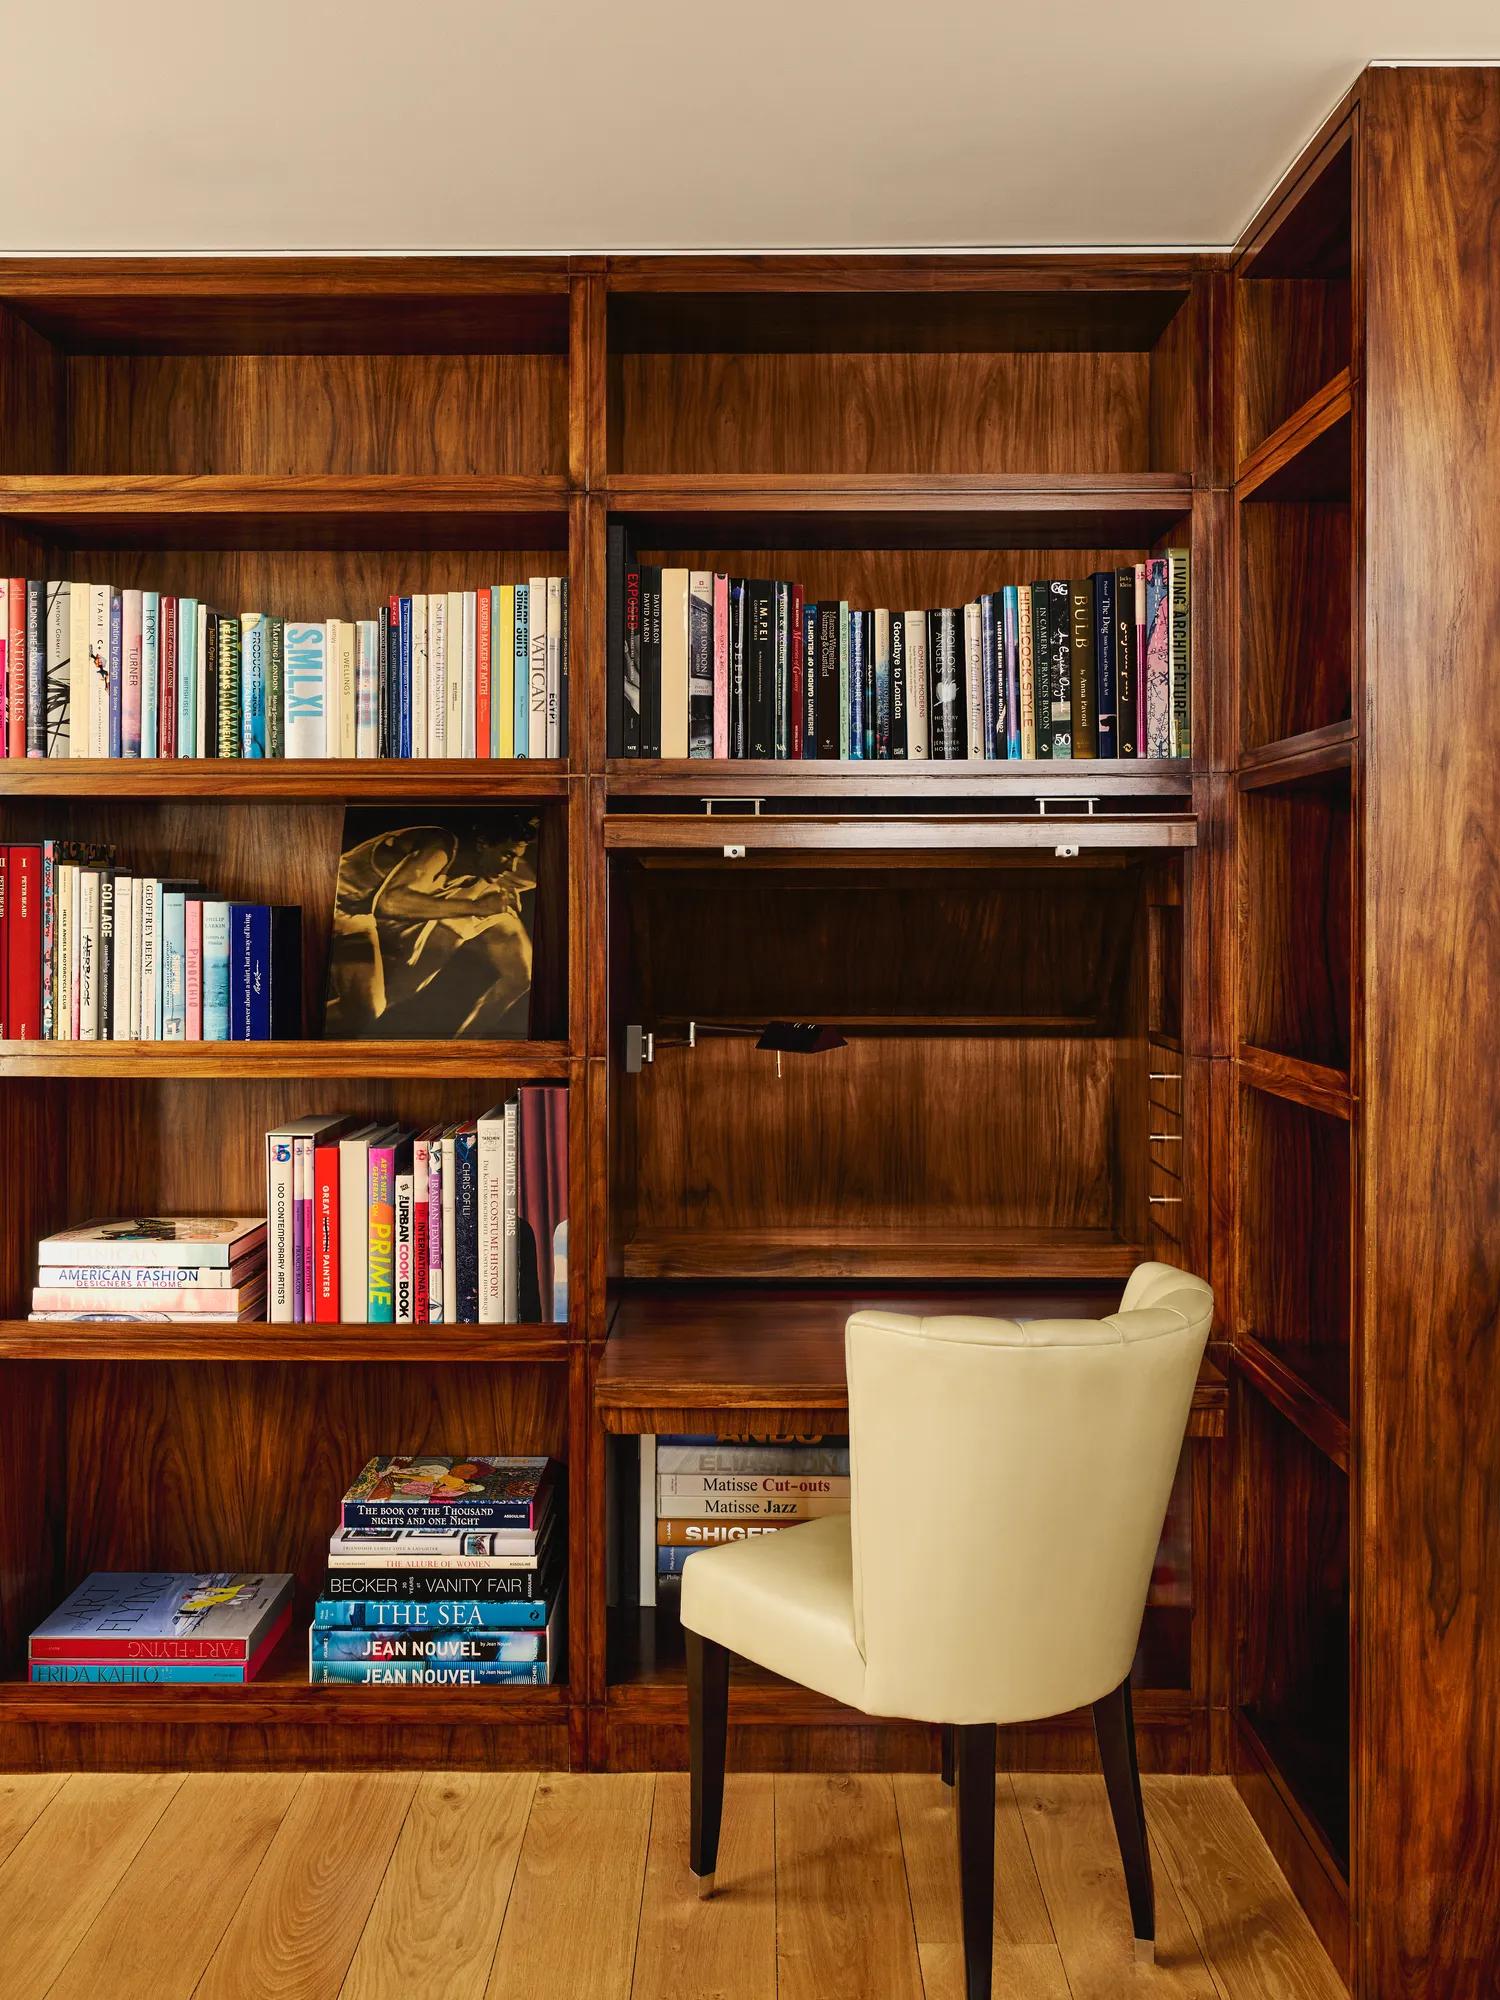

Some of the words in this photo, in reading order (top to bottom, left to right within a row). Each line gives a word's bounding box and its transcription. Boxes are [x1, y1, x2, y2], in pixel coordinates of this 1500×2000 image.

[1173, 557, 1187, 605] LIVING
[30, 591, 38, 628] BUILDING
[516, 590, 528, 625] SHARP
[626, 573, 639, 630] EXPOSED
[759, 599, 768, 620] I.M.
[1039, 607, 1047, 617] IN
[30, 631, 38, 645] THE
[111, 617, 120, 645] lighting
[145, 609, 155, 647] HORST
[222, 624, 231, 643] REAL
[435, 602, 444, 644] SCHOOL
[700, 613, 708, 634] LOST
[759, 622, 768, 641] PEI
[820, 611, 829, 641] Nutmeg
[1019, 591, 1032, 678] HITCHCOCK
[1039, 618, 1048, 656] CAMERA
[1073, 595, 1090, 649] BULB
[111, 646, 120, 655] by
[252, 631, 261, 678] PRODUCT
[272, 622, 281, 657] MAPPING
[435, 646, 444, 659] OF
[480, 635, 488, 662] MAKER
[516, 627, 528, 657] SUITS
[700, 635, 708, 673] LONDON
[827, 638, 836, 670] Wareing
[893, 621, 902, 664] Goodbye
[935, 631, 944, 674] ANGELS
[946, 622, 956, 673] APOLLO'S
[14, 628, 25, 722] ANTIQUAIRES
[30, 647, 38, 696] REVOLUTION
[111, 656, 120, 680] design
[129, 647, 139, 686] TURNER
[222, 646, 231, 690] AMERICANS
[272, 659, 281, 691] LONDON
[480, 662, 488, 671] OF
[531, 633, 545, 713] VATICAN
[734, 641, 743, 696] SEEDS
[807, 657, 814, 667] OF
[821, 648, 829, 677] Custard
[893, 667, 902, 678] to
[1173, 611, 1187, 718] ARCHITECTURE
[480, 672, 488, 695] MYTH
[1041, 661, 1049, 697] FRANCIS
[252, 680, 261, 716] DESIGN
[434, 661, 445, 742] HORSEMANSHIP
[549, 693, 558, 725] EGYPT
[893, 681, 902, 719] London
[1021, 682, 1033, 727] STYLE
[1042, 699, 1050, 729] BACON
[1053, 733, 1070, 745] 50
[101, 883, 113, 938] COLLAGE
[145, 885, 153, 938] GEOFFREY
[244, 913, 252, 931] living
[244, 931, 251, 939] of
[145, 940, 153, 975] BEENE
[188, 948, 198, 1008] PINOCCHIO
[244, 967, 252, 984] shirt,
[506, 1110, 516, 1148] ELLIOTT
[380, 1158, 388, 1180] ART'S
[462, 1162, 471, 1189] CHRIS
[506, 1150, 516, 1197] ERWITT'S
[322, 1185, 330, 1215] GREAT
[371, 1166, 379, 1217] GENERATION
[380, 1181, 388, 1202] NEXT
[431, 1178, 440, 1220] IRANIAN
[462, 1191, 471, 1216] OFILI
[490, 1177, 498, 1201] THE
[277, 1200, 285, 1269] CONTEMPORARY
[399, 1200, 410, 1242] URBAN
[490, 1201, 498, 1251] COSTUME
[506, 1207, 516, 1237] PARIS
[417, 1222, 426, 1296] INTERNATIONAL
[431, 1222, 440, 1265] TEXTILES
[59, 1269, 134, 1282] AMERICAN
[136, 1270, 199, 1282] FASHION
[322, 1254, 330, 1298] PAINTERS
[369, 1223, 391, 1306] PRIME
[399, 1244, 410, 1280] COOK
[490, 1253, 498, 1299] HISTORY
[76, 1280, 132, 1288] DESIGNERS
[136, 1280, 149, 1288] AT
[152, 1280, 183, 1288] HOME
[277, 1271, 285, 1305] ARTISTS
[399, 1281, 410, 1318] BOOK
[417, 1297, 426, 1324] STYLE
[703, 1478, 758, 1492] Matisse
[762, 1478, 831, 1493] Cut-outs
[357, 1505, 379, 1515] THE
[380, 1505, 405, 1516] BOOK
[407, 1506, 419, 1516] OF
[422, 1506, 440, 1516] THE
[443, 1505, 494, 1517] THOUSAND
[371, 1517, 404, 1525] NIGHTS
[406, 1517, 426, 1525] AND
[428, 1517, 447, 1525] ONE
[449, 1516, 480, 1526] NIGHT
[704, 1500, 760, 1513] Matisse
[763, 1500, 798, 1514] Jazz
[685, 1526, 783, 1542] SHIGE
[386, 1559, 404, 1568] THE
[406, 1559, 440, 1568] ALLURE
[441, 1559, 452, 1568] OF
[456, 1559, 491, 1568] WOMEN
[330, 1578, 398, 1593] BECKER
[425, 1578, 482, 1593] VANITY
[487, 1578, 522, 1593] FAIR
[64, 1586, 120, 1623] ART
[95, 1576, 177, 1633] FLYING
[372, 1604, 429, 1626] THE
[437, 1604, 485, 1626] SEA
[128, 1641, 188, 1658] FLYING
[196, 1642, 234, 1657] ART
[362, 1641, 407, 1656] JEAN
[412, 1641, 481, 1656] NOUVEL
[37, 1666, 91, 1683] FRIDA
[97, 1666, 160, 1683] KAHLO
[362, 1669, 407, 1684] JEAN
[412, 1669, 481, 1684] NOUVEL
